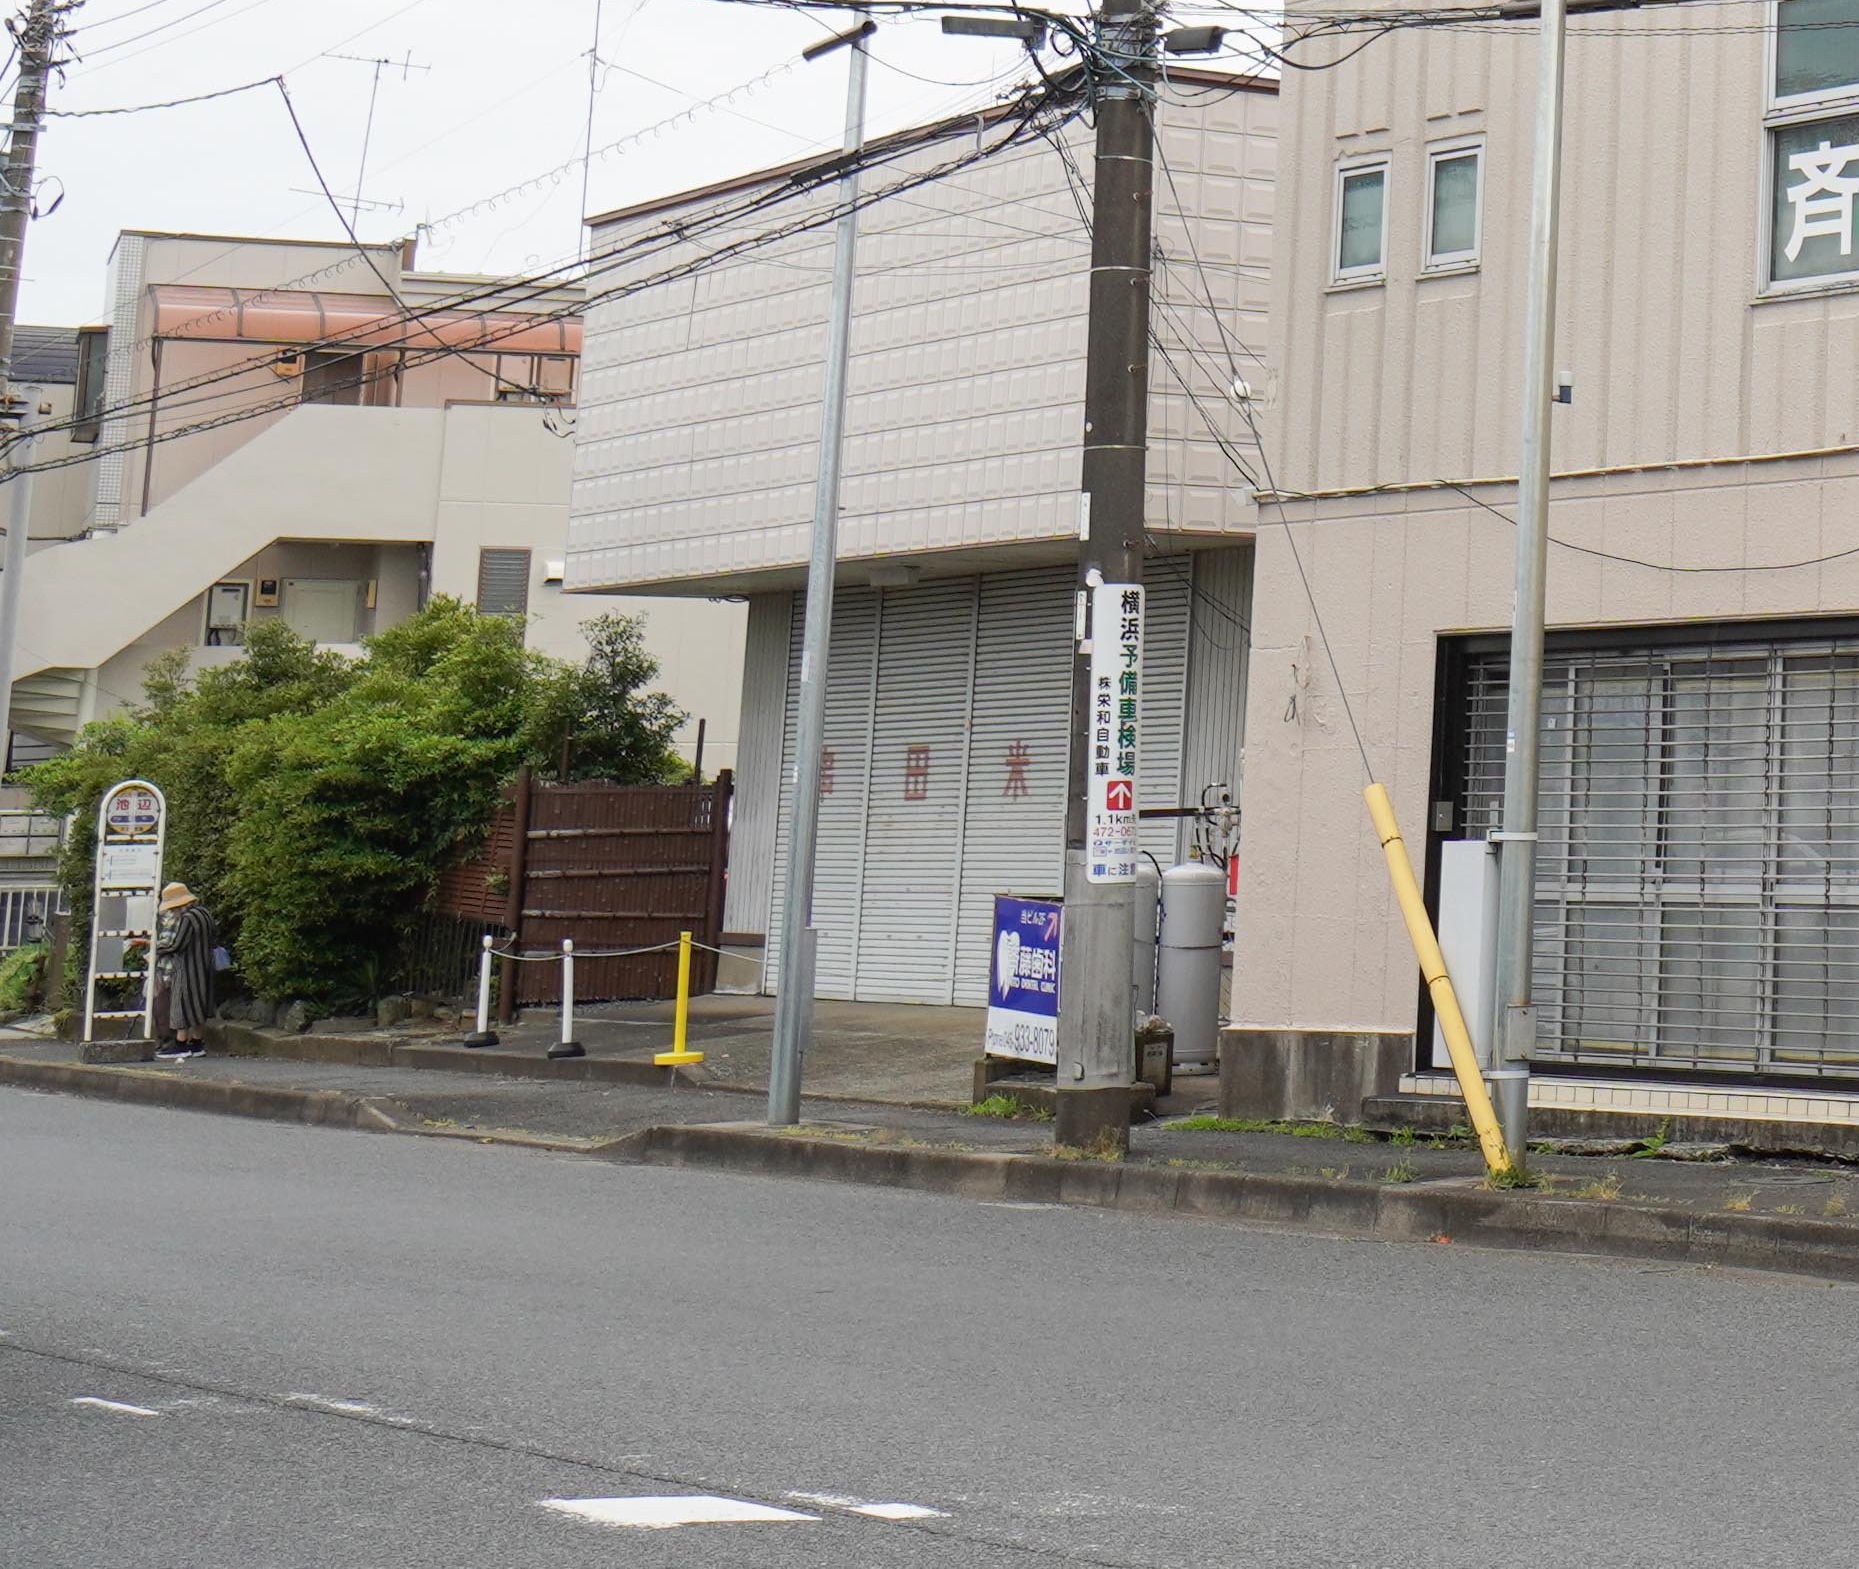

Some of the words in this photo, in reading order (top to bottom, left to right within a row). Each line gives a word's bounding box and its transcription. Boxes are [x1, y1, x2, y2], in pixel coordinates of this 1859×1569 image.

[1117, 590, 1140, 776] 横浜予備車検場
